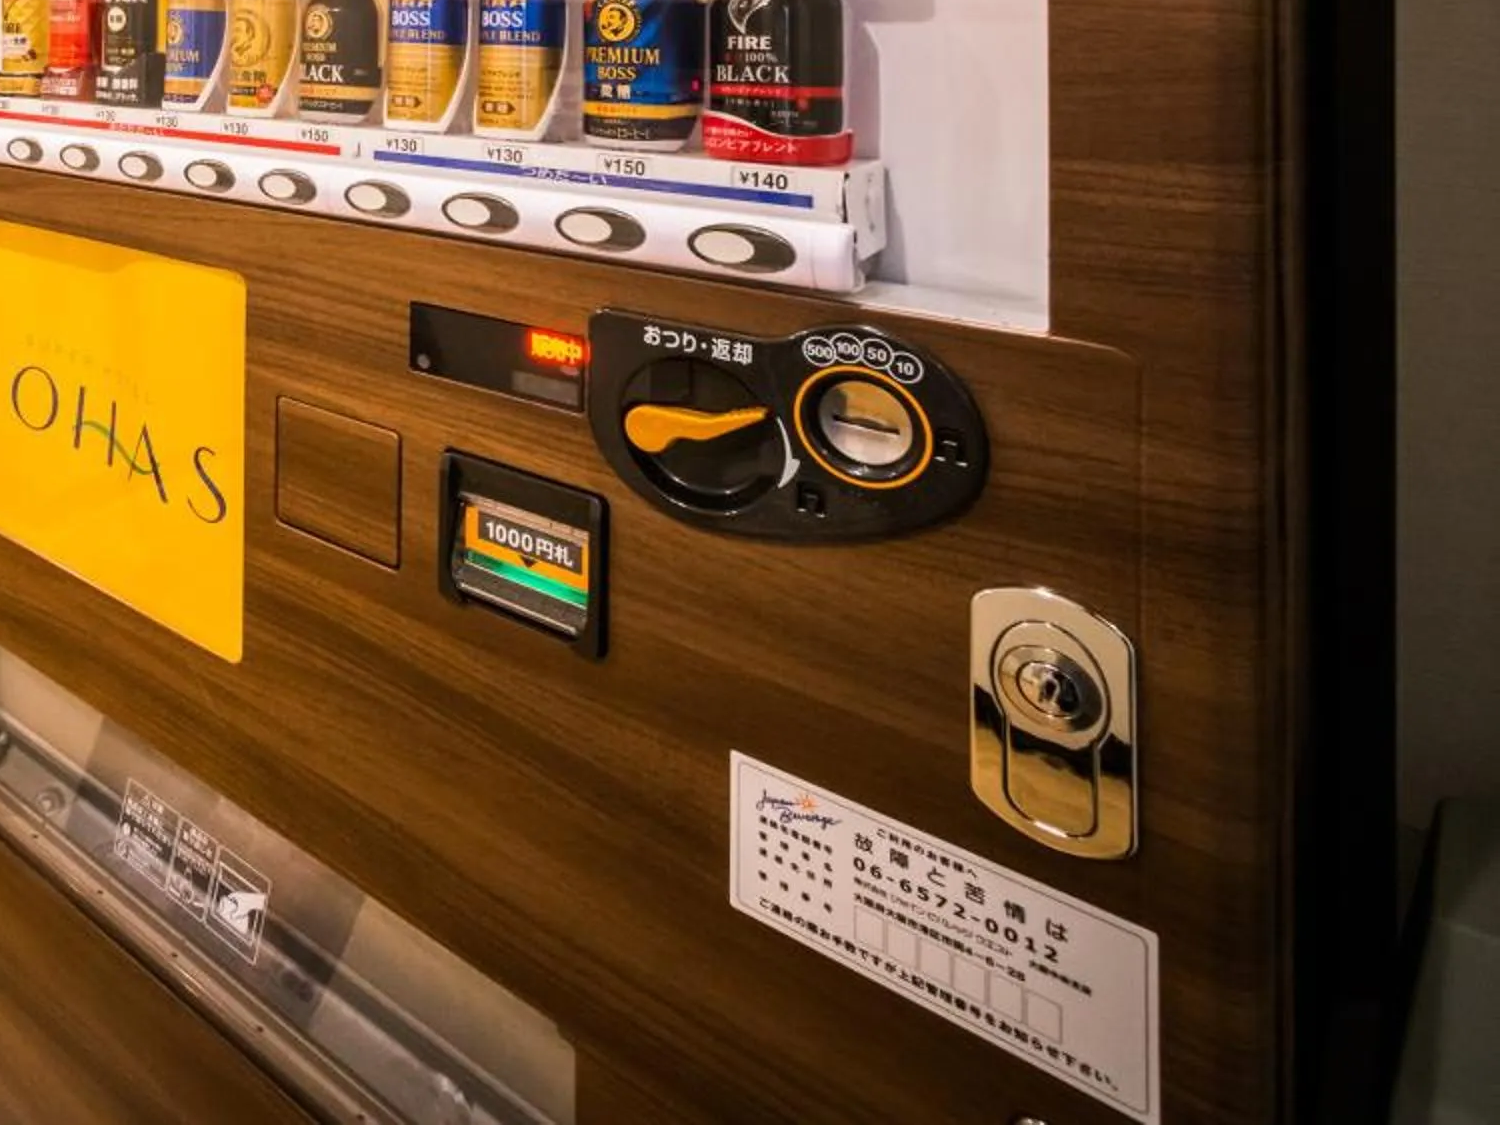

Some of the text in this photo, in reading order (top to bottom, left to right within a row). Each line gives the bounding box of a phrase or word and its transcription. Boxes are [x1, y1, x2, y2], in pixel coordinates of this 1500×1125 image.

[482, 10, 524, 28] BOSS
[727, 36, 772, 50] FIRE
[586, 46, 661, 65] REMIUM
[744, 52, 779, 64] 100%
[299, 64, 345, 84] LACK
[597, 66, 637, 81] BOSS
[716, 64, 790, 84] BLACK
[386, 137, 418, 153] ¥130
[487, 148, 524, 165] ¥130
[603, 158, 646, 177] ¥150
[739, 170, 789, 192] ¥140
[642, 324, 754, 366] おつり・返却
[805, 340, 916, 377] 500 100 50 10
[484, 518, 575, 570] 1000円札
[853, 831, 1070, 944] 故障と苦情は
[852, 856, 1060, 965] 06-6572-0012
